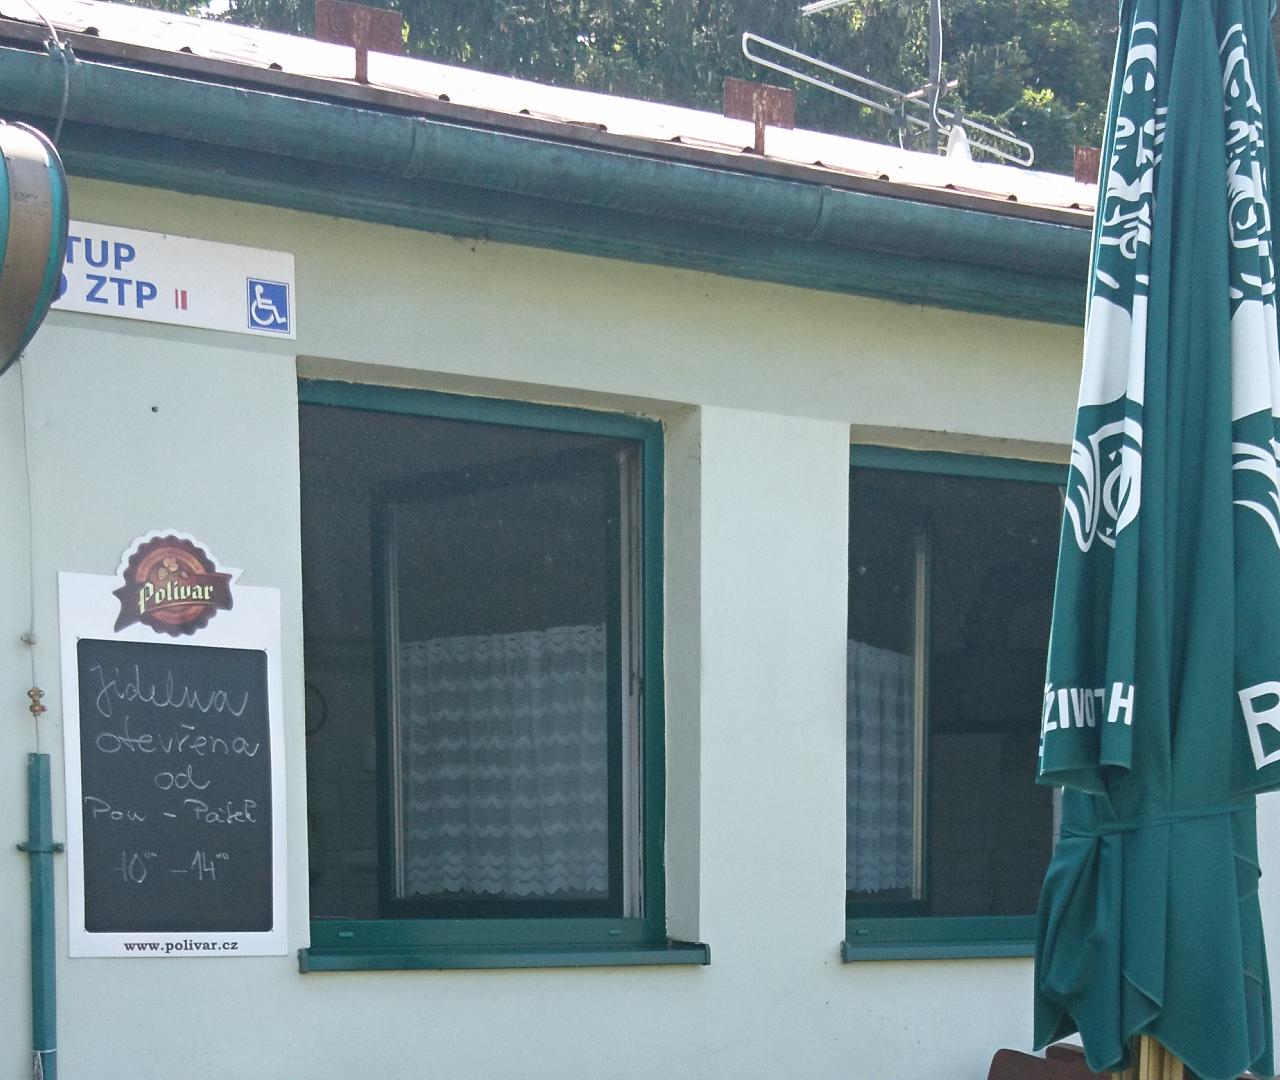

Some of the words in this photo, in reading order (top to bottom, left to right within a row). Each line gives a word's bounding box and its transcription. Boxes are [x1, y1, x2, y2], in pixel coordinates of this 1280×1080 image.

[67, 236, 136, 270] TUP
[86, 273, 157, 308] ZTP
[138, 580, 214, 615] Polivar
[155, 764, 210, 790] od
[124, 938, 239, 953] www.polivar.cz
